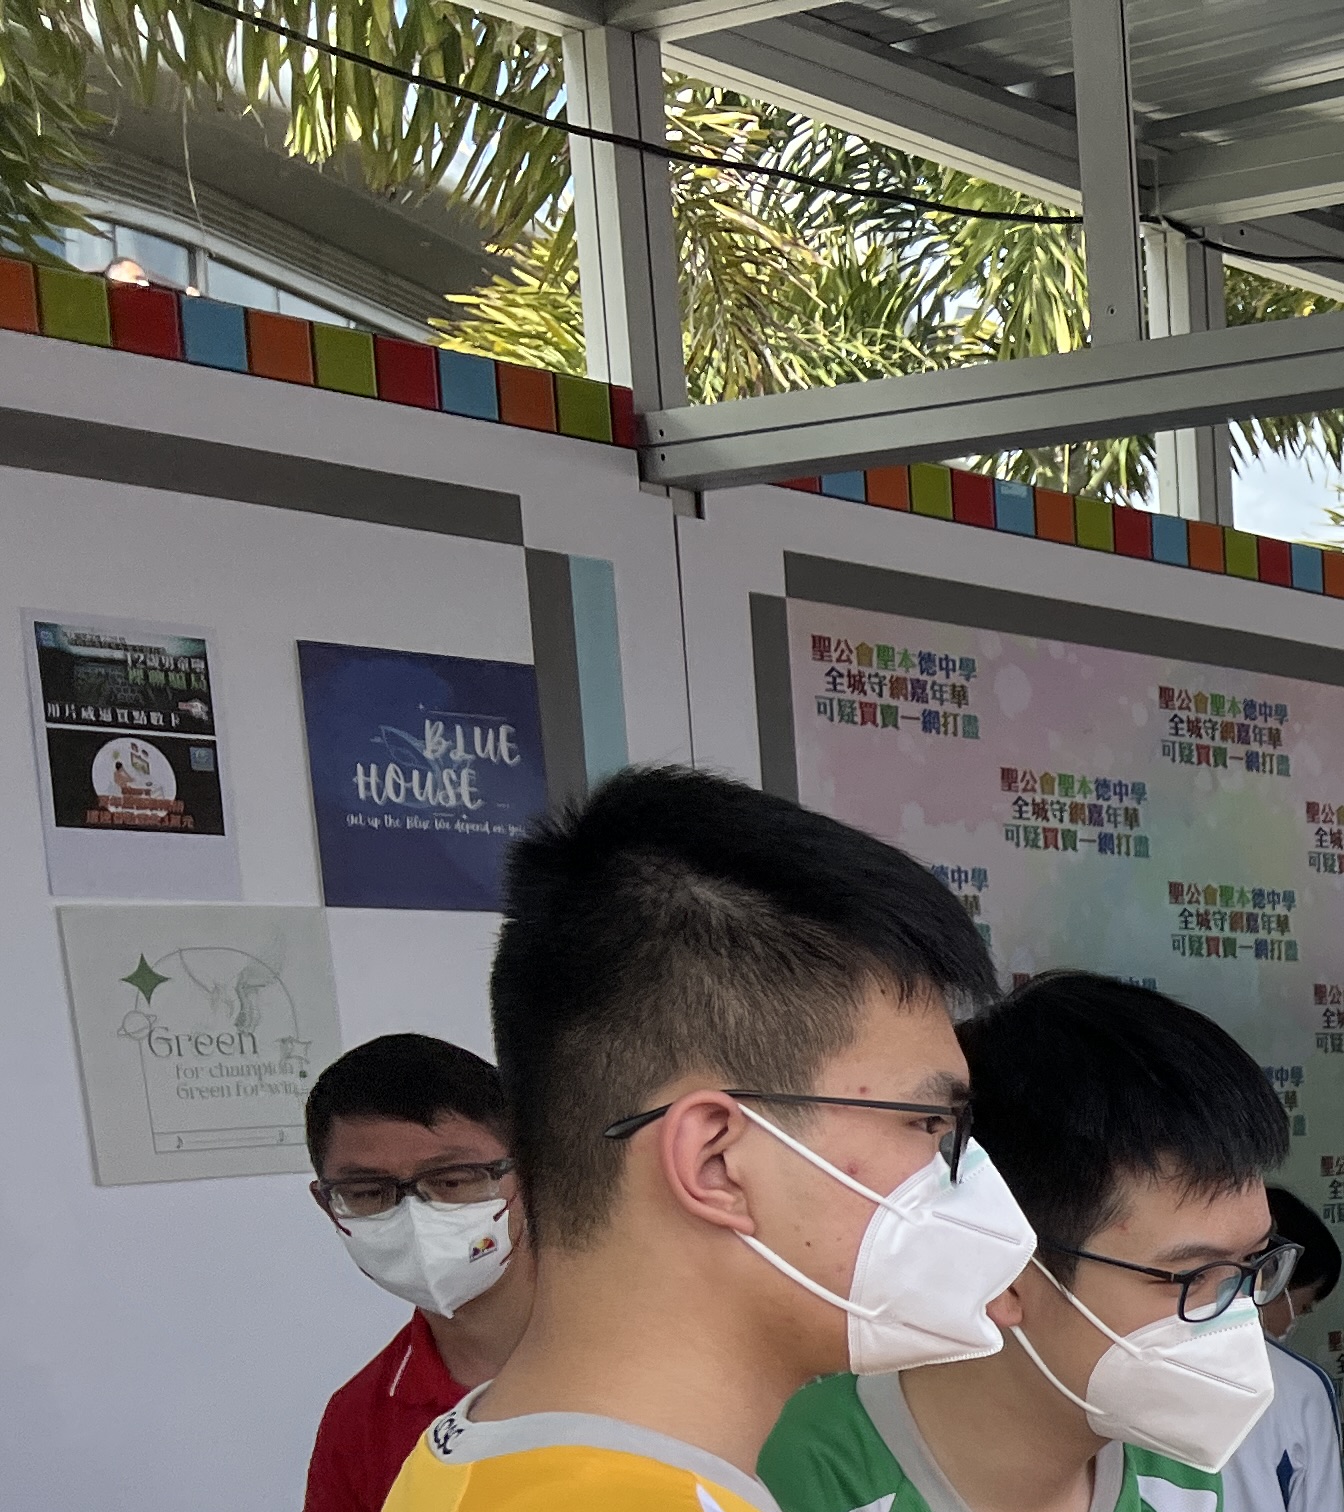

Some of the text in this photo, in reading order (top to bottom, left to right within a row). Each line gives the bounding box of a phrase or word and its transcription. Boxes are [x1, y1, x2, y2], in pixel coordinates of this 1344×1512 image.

[811, 634, 978, 682] 聖公會聖本德中學
[825, 666, 969, 708] 全城守網嘉年華
[423, 719, 521, 767] BLUE
[353, 762, 484, 810] HOUSE
[148, 1026, 258, 1058] Green
